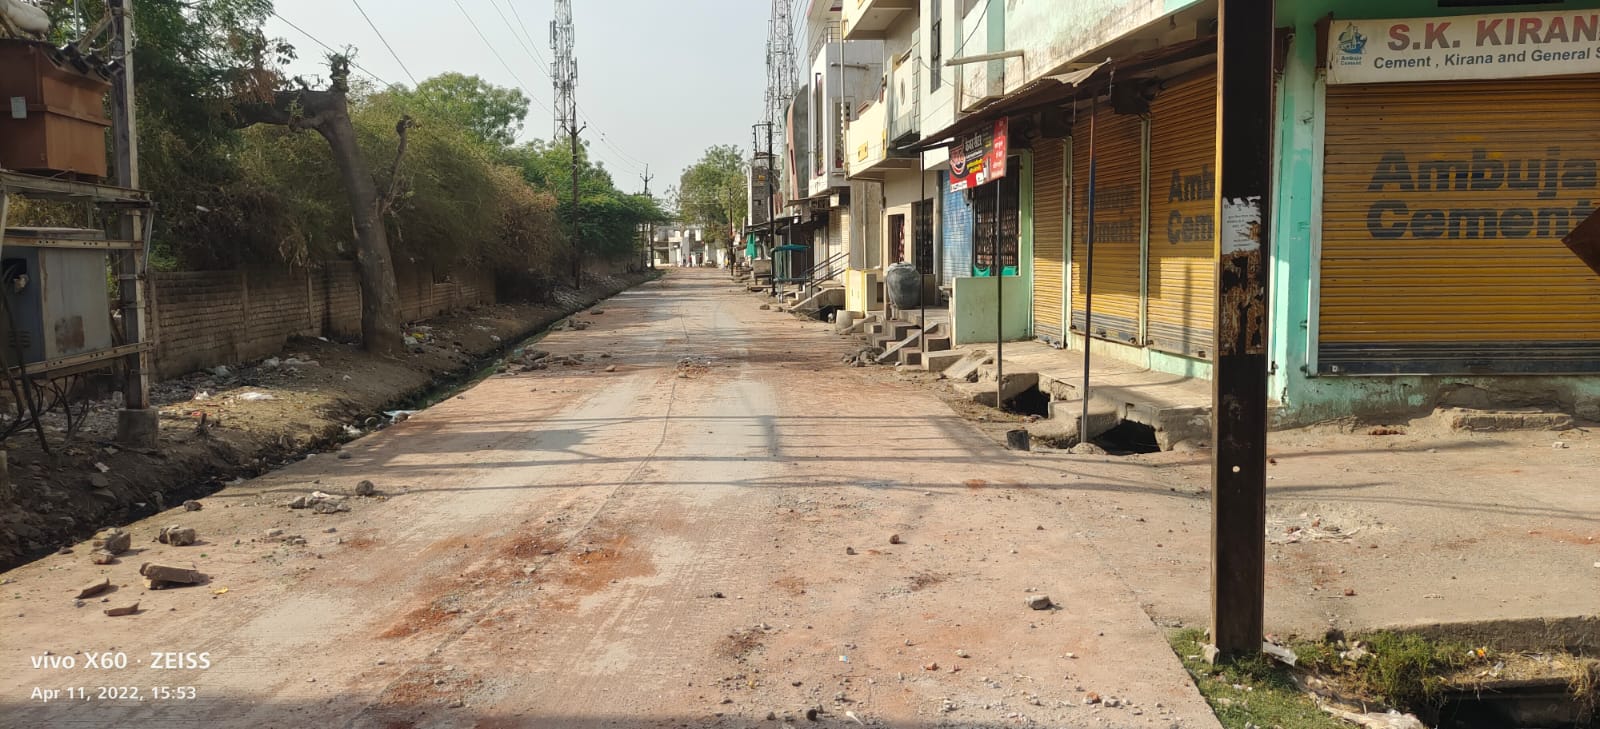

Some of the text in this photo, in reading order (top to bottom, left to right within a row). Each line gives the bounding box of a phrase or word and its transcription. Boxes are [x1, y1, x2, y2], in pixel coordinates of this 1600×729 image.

[1387, 14, 1600, 51] S.K. KIRAN
[1374, 55, 1431, 69] Cement
[1444, 52, 1493, 67] Kirana
[1498, 50, 1526, 63] and
[1531, 47, 1590, 62] General
[1168, 163, 1214, 203] Amb
[1368, 146, 1597, 198] Ambuja
[1168, 208, 1214, 244] Cem
[1366, 199, 1596, 238] Cement
